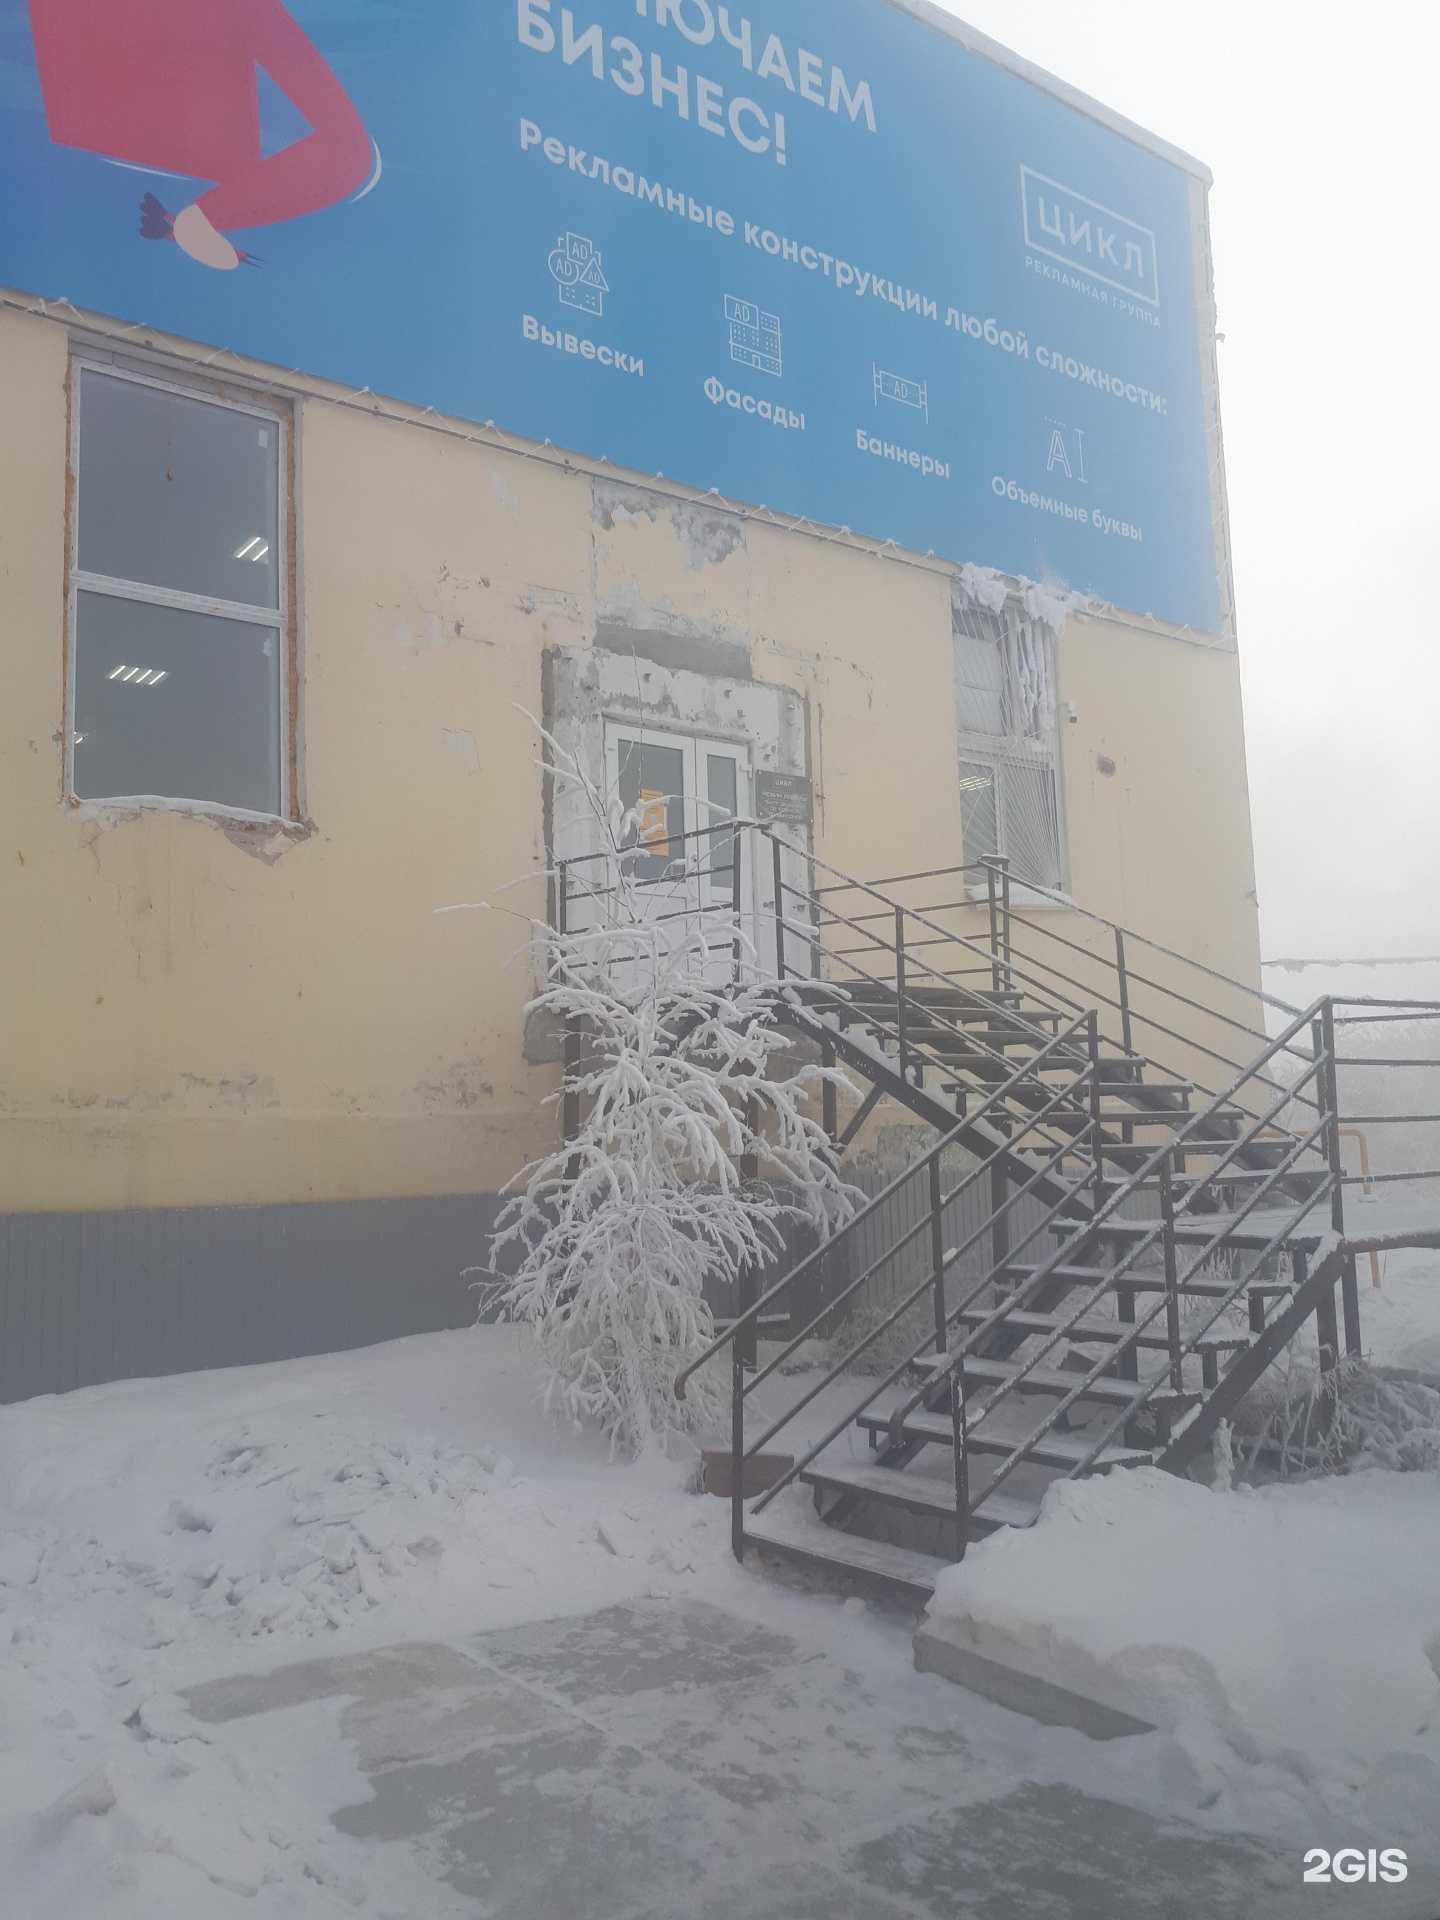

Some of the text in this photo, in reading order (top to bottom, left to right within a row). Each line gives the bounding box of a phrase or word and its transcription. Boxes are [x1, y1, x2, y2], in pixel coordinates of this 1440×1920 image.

[517, 0, 787, 166] БИЗНЕС!
[636, 0, 878, 133] ЮЧАЕМ
[519, 118, 1167, 415] Рекламные конструкции любой сложности:
[555, 258, 572, 276] AD
[571, 241, 588, 260] AD
[1038, 197, 1145, 278] ЦИКЛ
[735, 303, 750, 322] AD
[1025, 256, 1161, 328] РЕКЛАМНАЯ ГРУППА
[522, 314, 644, 377] Вывески
[704, 376, 805, 430] Фасады
[856, 429, 950, 479] Баннеры
[991, 475, 1143, 542] Объемные буквы
